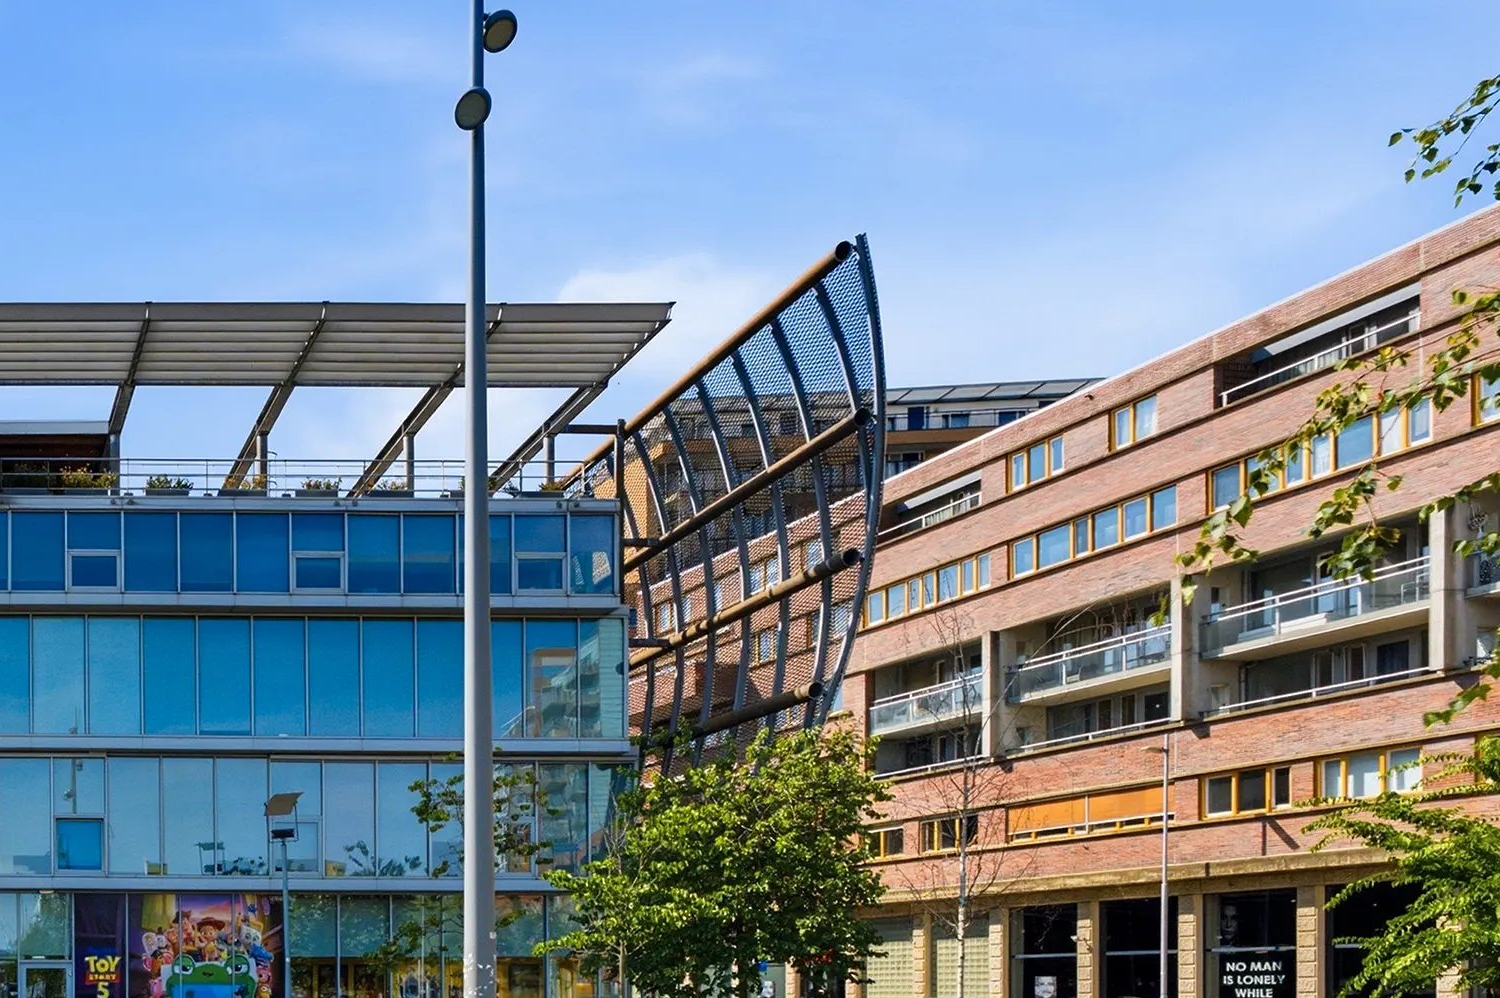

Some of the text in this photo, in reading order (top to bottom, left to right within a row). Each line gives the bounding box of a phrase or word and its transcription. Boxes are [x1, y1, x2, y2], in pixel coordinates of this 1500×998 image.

[84, 955, 121, 973] TOY
[1226, 962, 1282, 972] NO MAN
[1223, 974, 1285, 985] IS LONELY
[1235, 988, 1273, 998] WHILE
